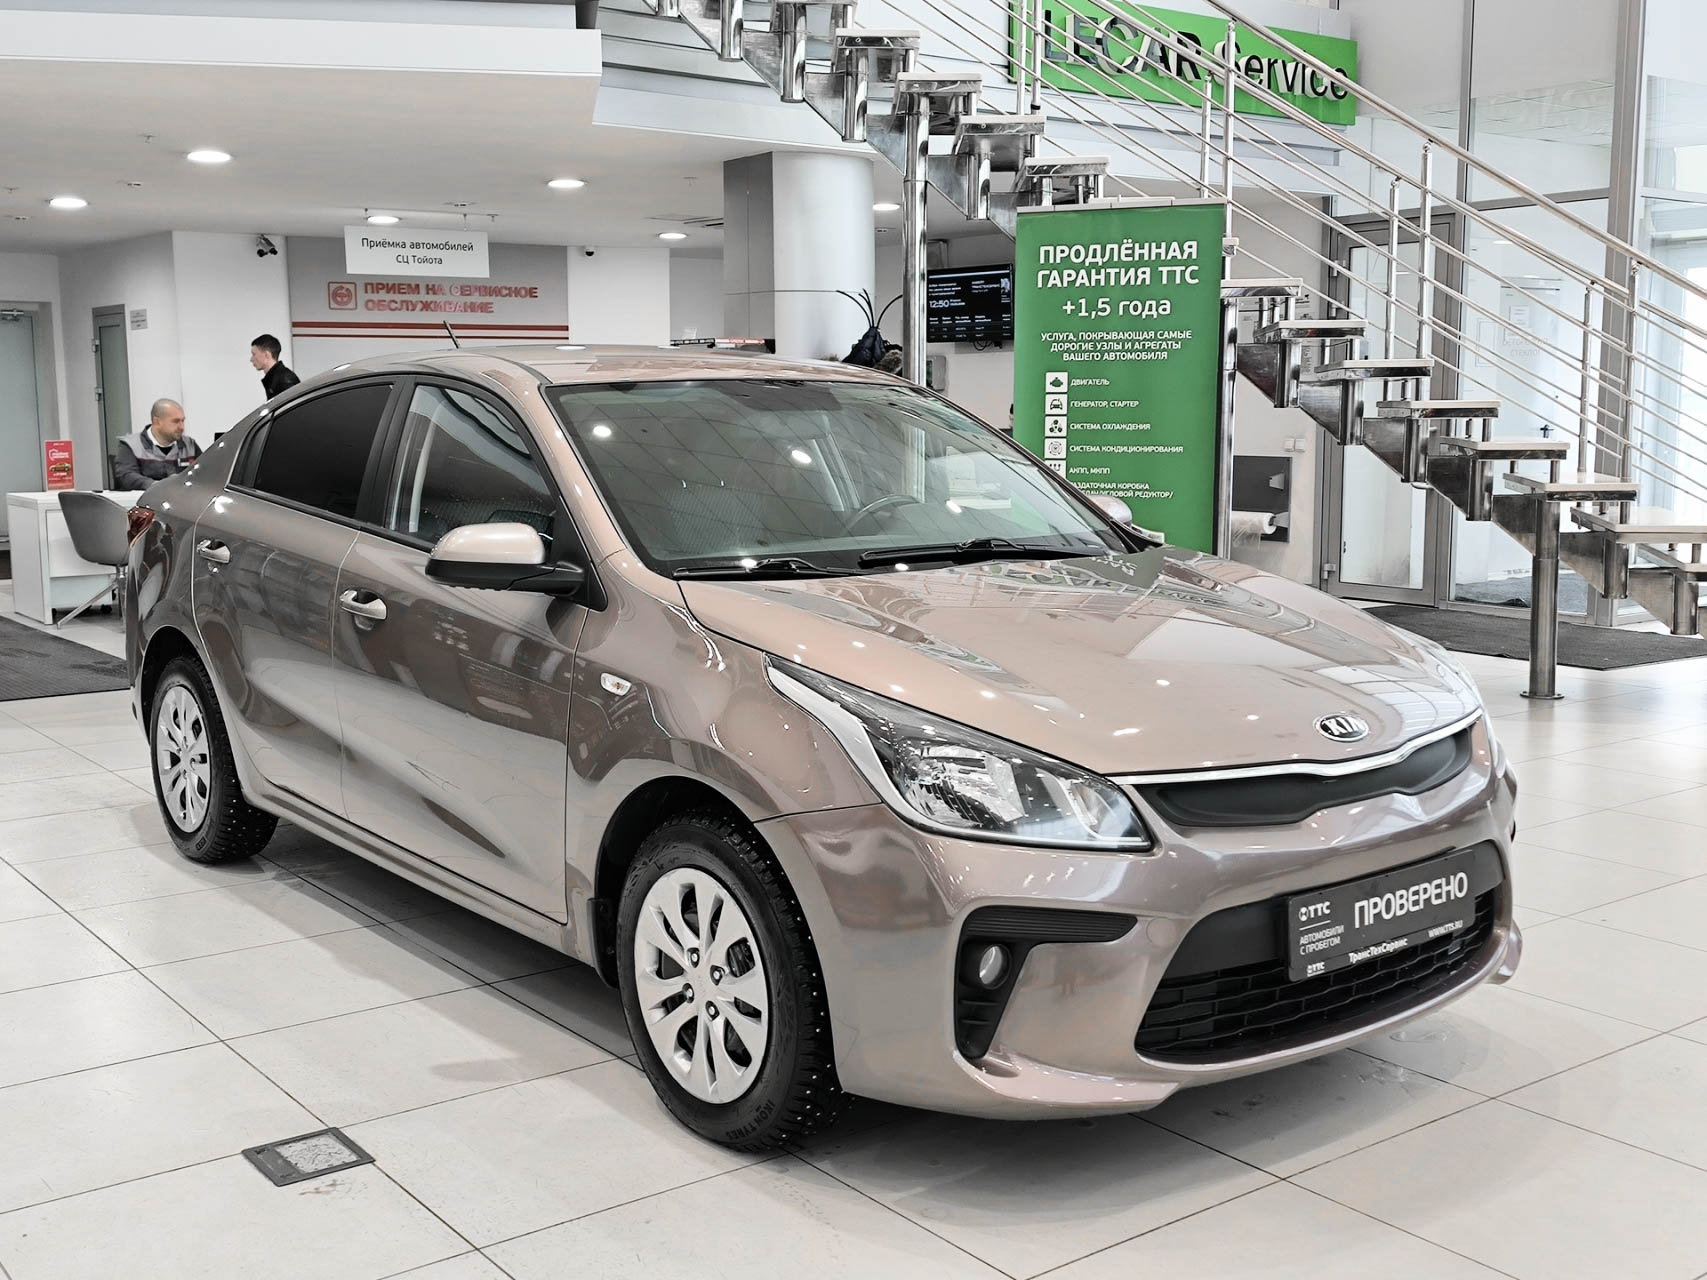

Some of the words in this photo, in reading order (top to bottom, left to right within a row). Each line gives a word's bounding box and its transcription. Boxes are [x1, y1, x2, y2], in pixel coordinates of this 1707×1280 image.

[1043, 10, 1202, 80] LECAR
[1213, 40, 1350, 100] Service
[361, 238, 407, 250] Приёмка
[409, 240, 474, 252] автомобилей
[1038, 239, 1198, 266] ПРОДЛЁННАЯ
[395, 254, 410, 265] СЦ
[412, 255, 443, 265] Тойота
[1037, 267, 1151, 288] ГАРАНТИЯ
[1158, 265, 1200, 285] ТТС
[364, 282, 421, 295] ПРИЕМ
[425, 284, 446, 296] НА
[450, 285, 539, 299] СЕРВИСНОЕ
[364, 299, 495, 314] ОБСЛУЖИВАНИЕ
[1062, 298, 1112, 320] +1,5
[1118, 299, 1172, 319] года
[1041, 333, 1077, 342] УСЛУГА,
[1079, 331, 1155, 341] ПОКРЫВАЮЩАЯ
[1157, 330, 1193, 339] САМЫЕ
[1051, 342, 1095, 353] ДОРОГИЕ
[1096, 342, 1122, 351] УЗЛЫ
[1124, 341, 1131, 350] И
[1133, 341, 1182, 350] АГРЕГАТЫ
[1063, 352, 1101, 361] ВАШЕГО
[1103, 351, 1168, 361] АВТОМОБИЛЯ
[1071, 378, 1110, 387] ДВИГАТЕЛЬ
[1109, 400, 1140, 408] СТАРТЕР
[1070, 423, 1101, 431] СИСТЕМА
[1102, 423, 1151, 431] ОХЛАЖДЕНИЯ
[1069, 445, 1100, 453] СИСТЕМА
[1101, 446, 1184, 454] КОНДИЦИОНИРОВАНИЯ
[1069, 467, 1089, 475] АКПП,
[1090, 467, 1111, 475] МКПП
[1355, 872, 1468, 929] ПРОВЕРЕНО
[1308, 901, 1331, 918] ТТС
[1300, 925, 1345, 945] АВТОМОБИЛИ
[1300, 946, 1305, 955] С
[1306, 936, 1341, 954] ПРОБЕГОМ
[1349, 938, 1408, 964] ТрансТехСервис
